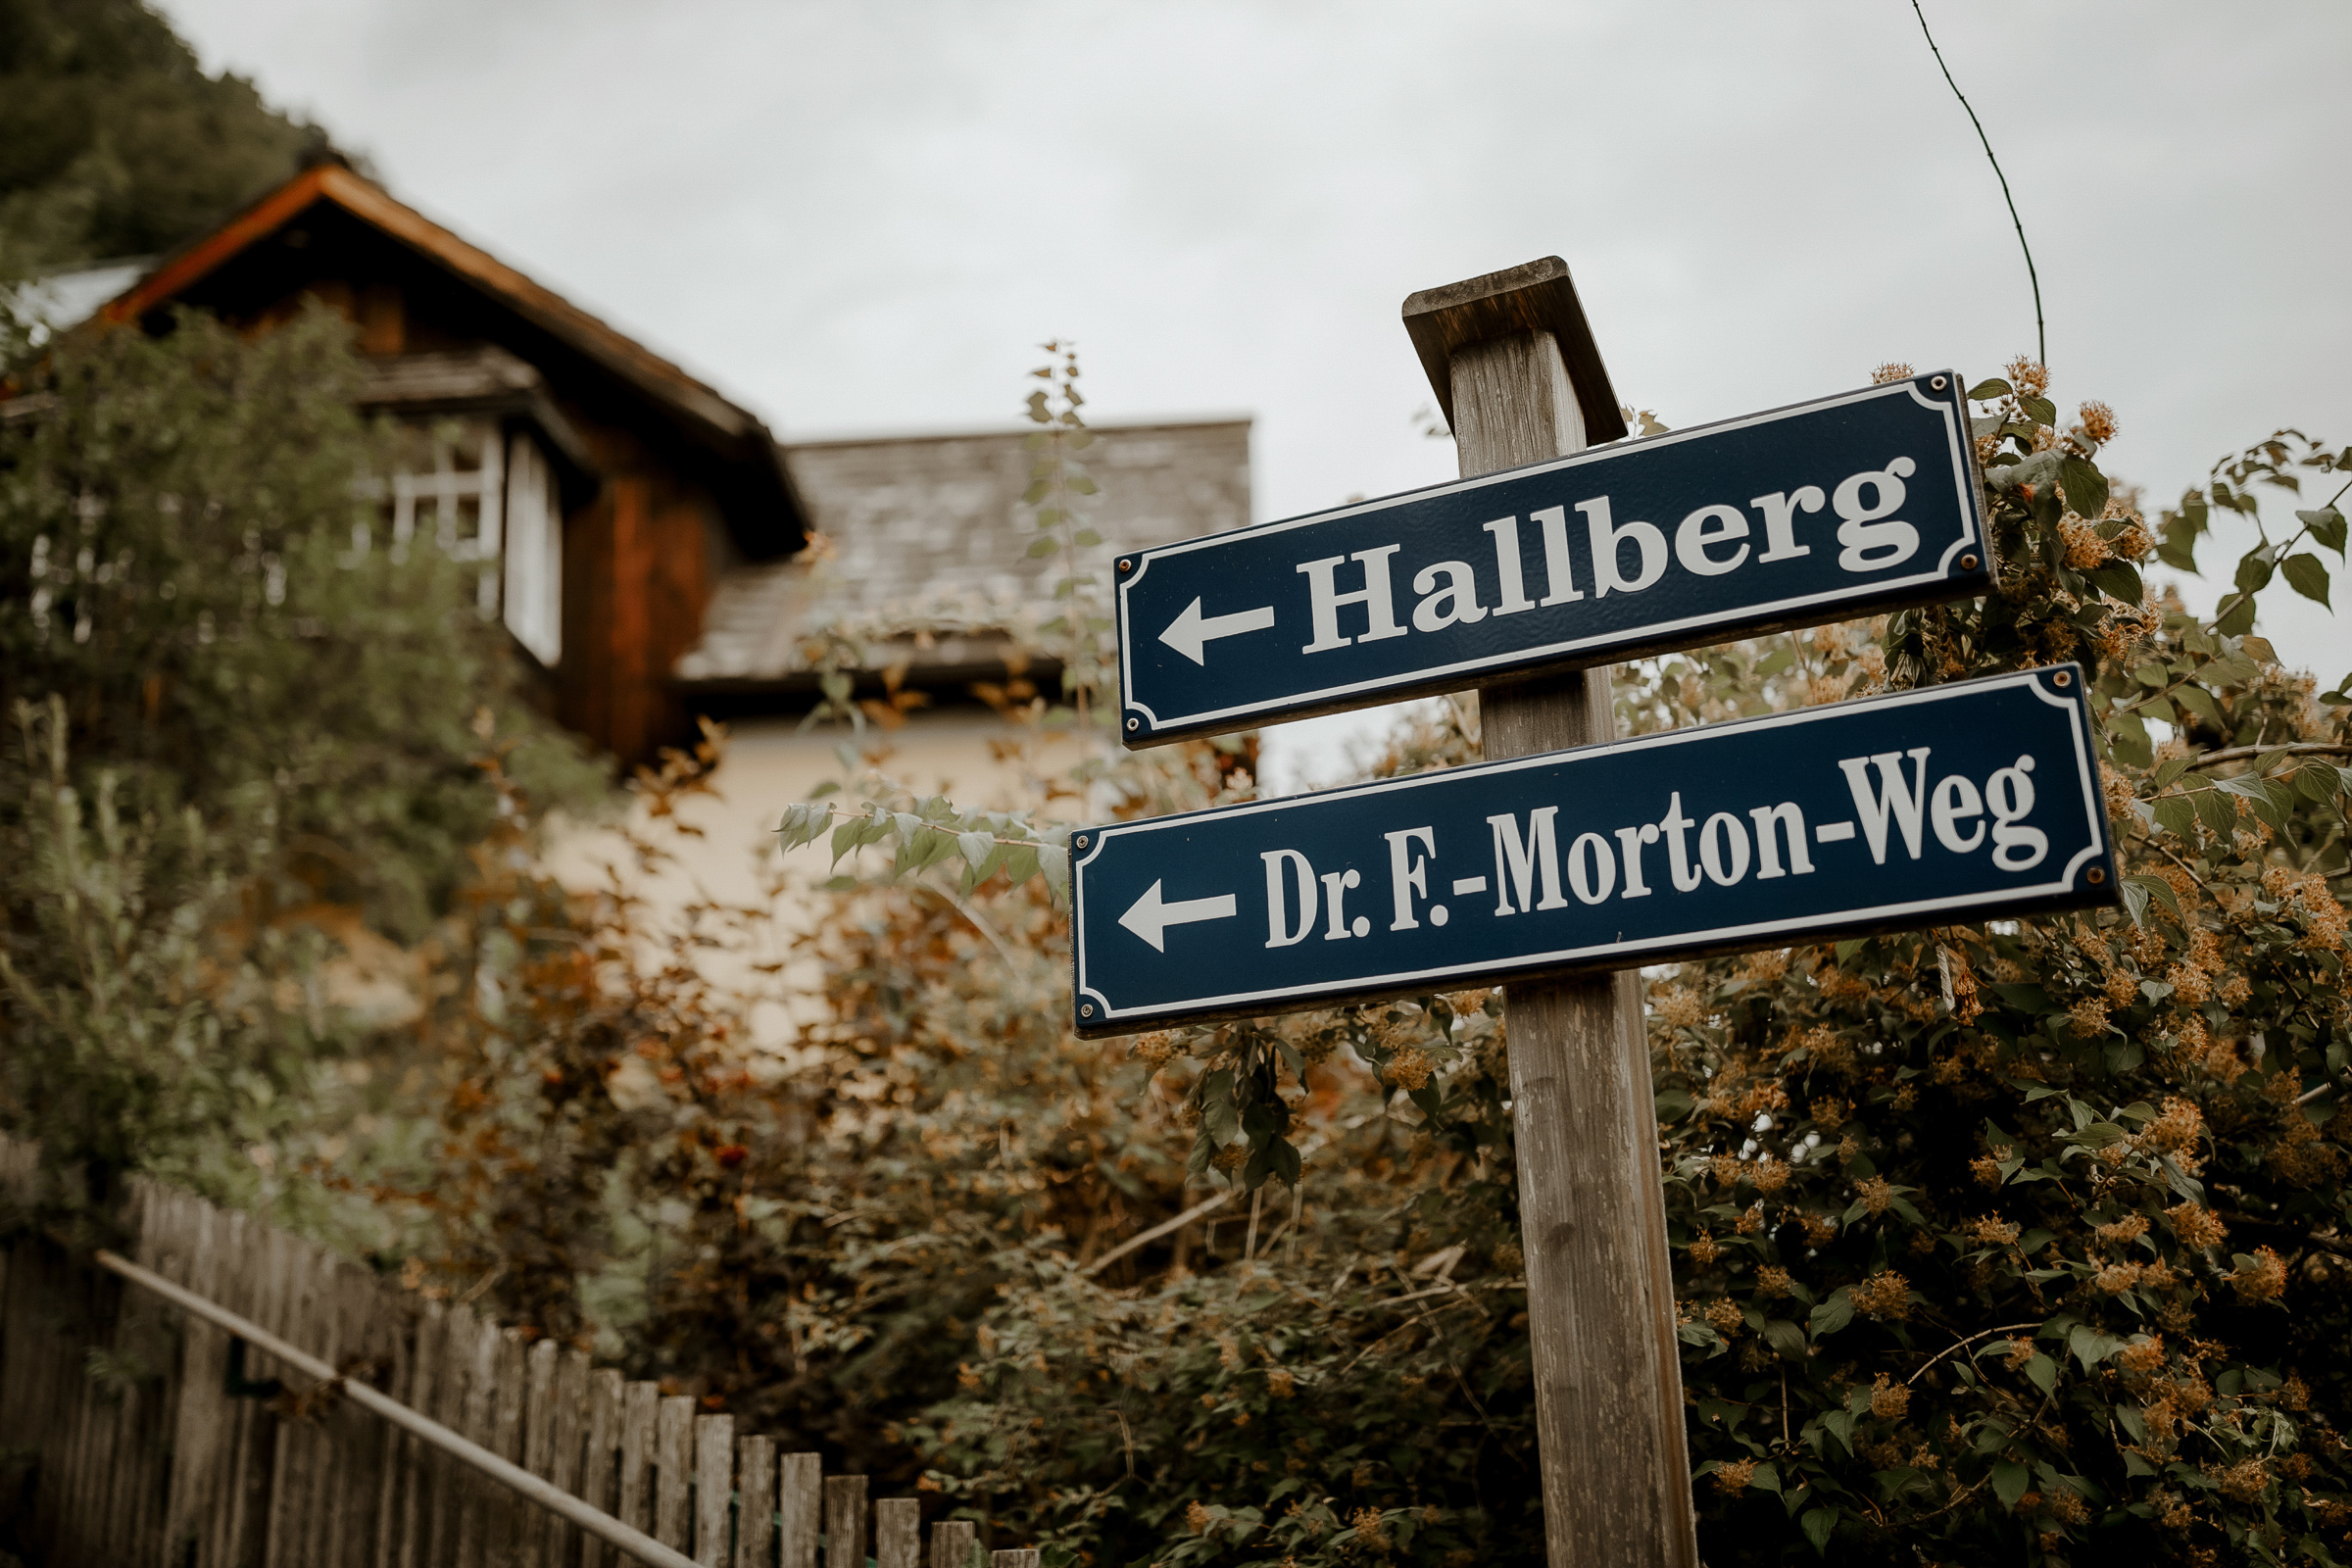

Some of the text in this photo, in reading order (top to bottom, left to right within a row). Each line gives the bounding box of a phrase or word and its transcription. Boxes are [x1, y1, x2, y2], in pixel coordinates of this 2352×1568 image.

[1296, 456, 1920, 655] Hallberg
[1259, 747, 2048, 949] Dr. F.-Morton-Weg
